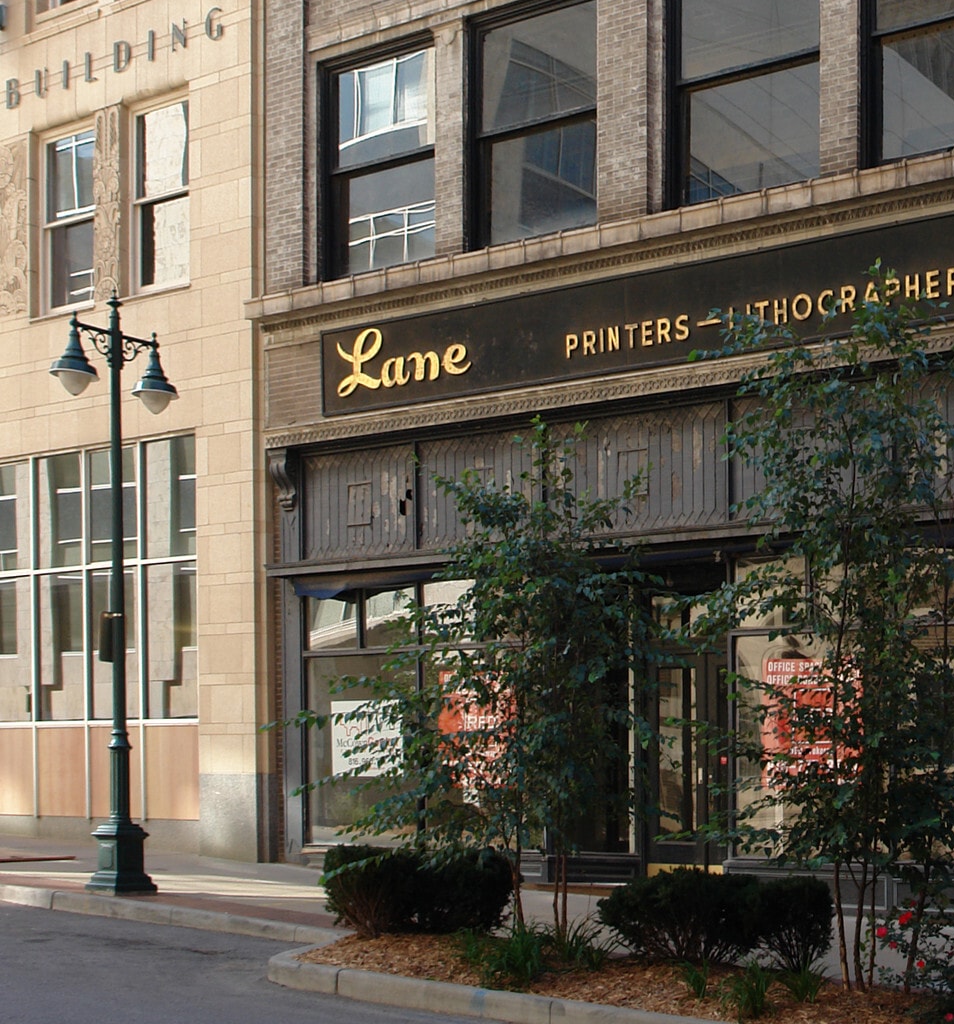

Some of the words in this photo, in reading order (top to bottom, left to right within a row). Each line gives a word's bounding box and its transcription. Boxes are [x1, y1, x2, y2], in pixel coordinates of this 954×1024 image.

[5, 6, 224, 110] BUILDING
[336, 327, 472, 398] Lane
[565, 314, 691, 360] PRINTERS
[767, 661, 796, 673] OFFICE
